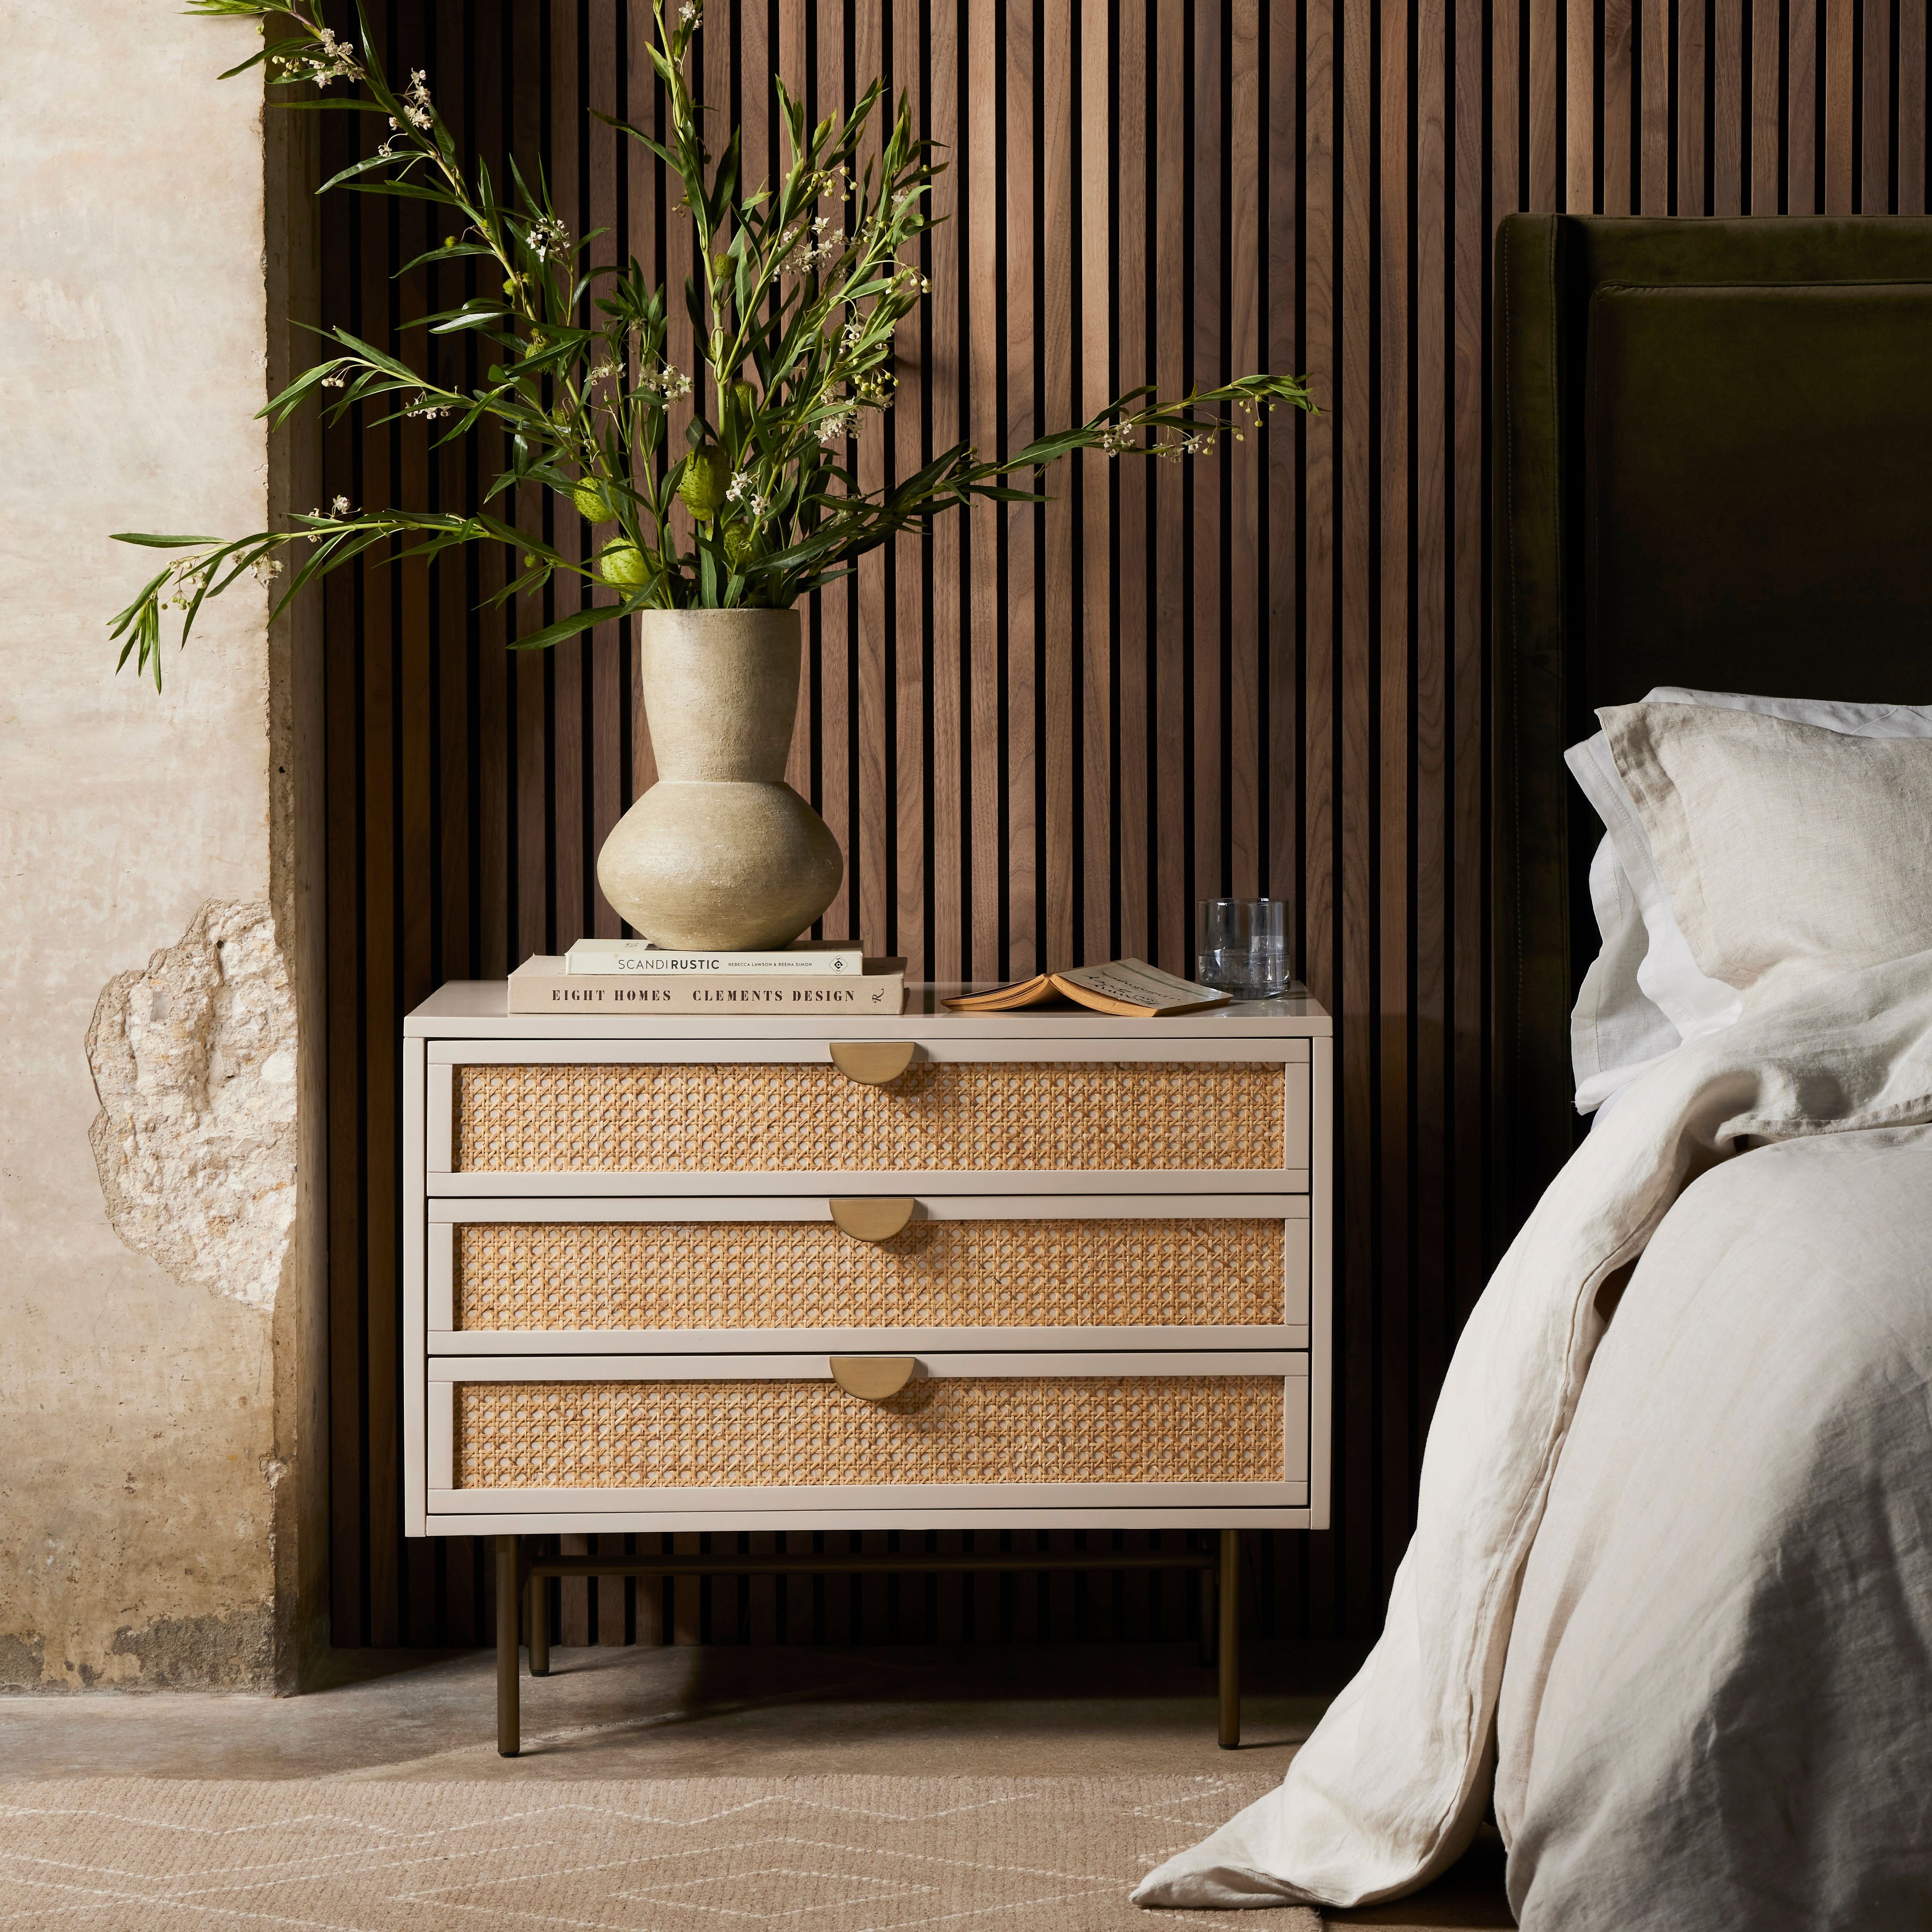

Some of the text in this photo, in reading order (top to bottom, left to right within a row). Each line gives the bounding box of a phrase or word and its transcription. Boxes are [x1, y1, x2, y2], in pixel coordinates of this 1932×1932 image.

[553, 990, 854, 1001] EIGHT HOMES CLEMENTS DESIGN
